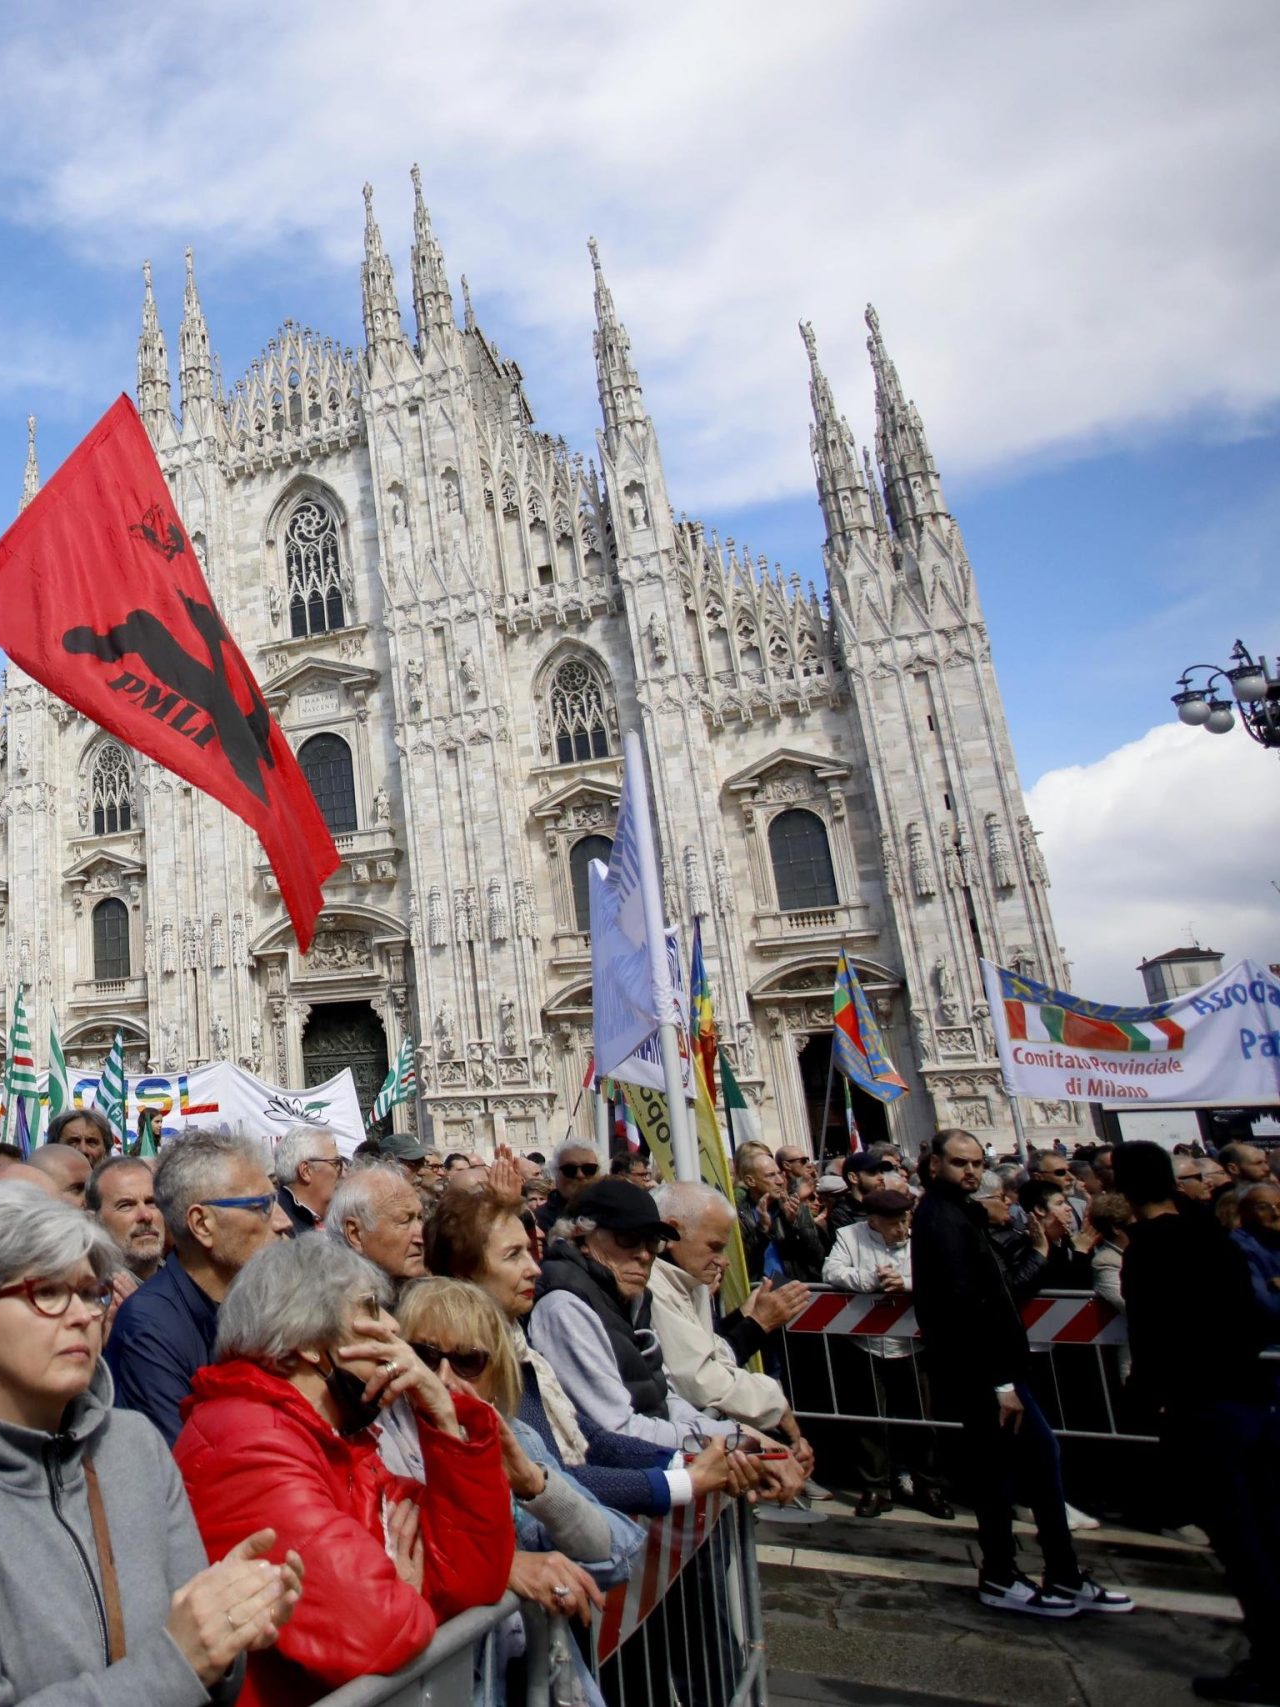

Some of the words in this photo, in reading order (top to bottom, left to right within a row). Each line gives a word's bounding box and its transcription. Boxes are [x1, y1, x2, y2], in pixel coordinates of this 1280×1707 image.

[107, 670, 217, 751] PMLI
[1012, 1047, 1091, 1070] Comitato
[1091, 1056, 1183, 1077] Provinciale
[1065, 1078, 1082, 1096] di
[1087, 1078, 1148, 1099] Milano
